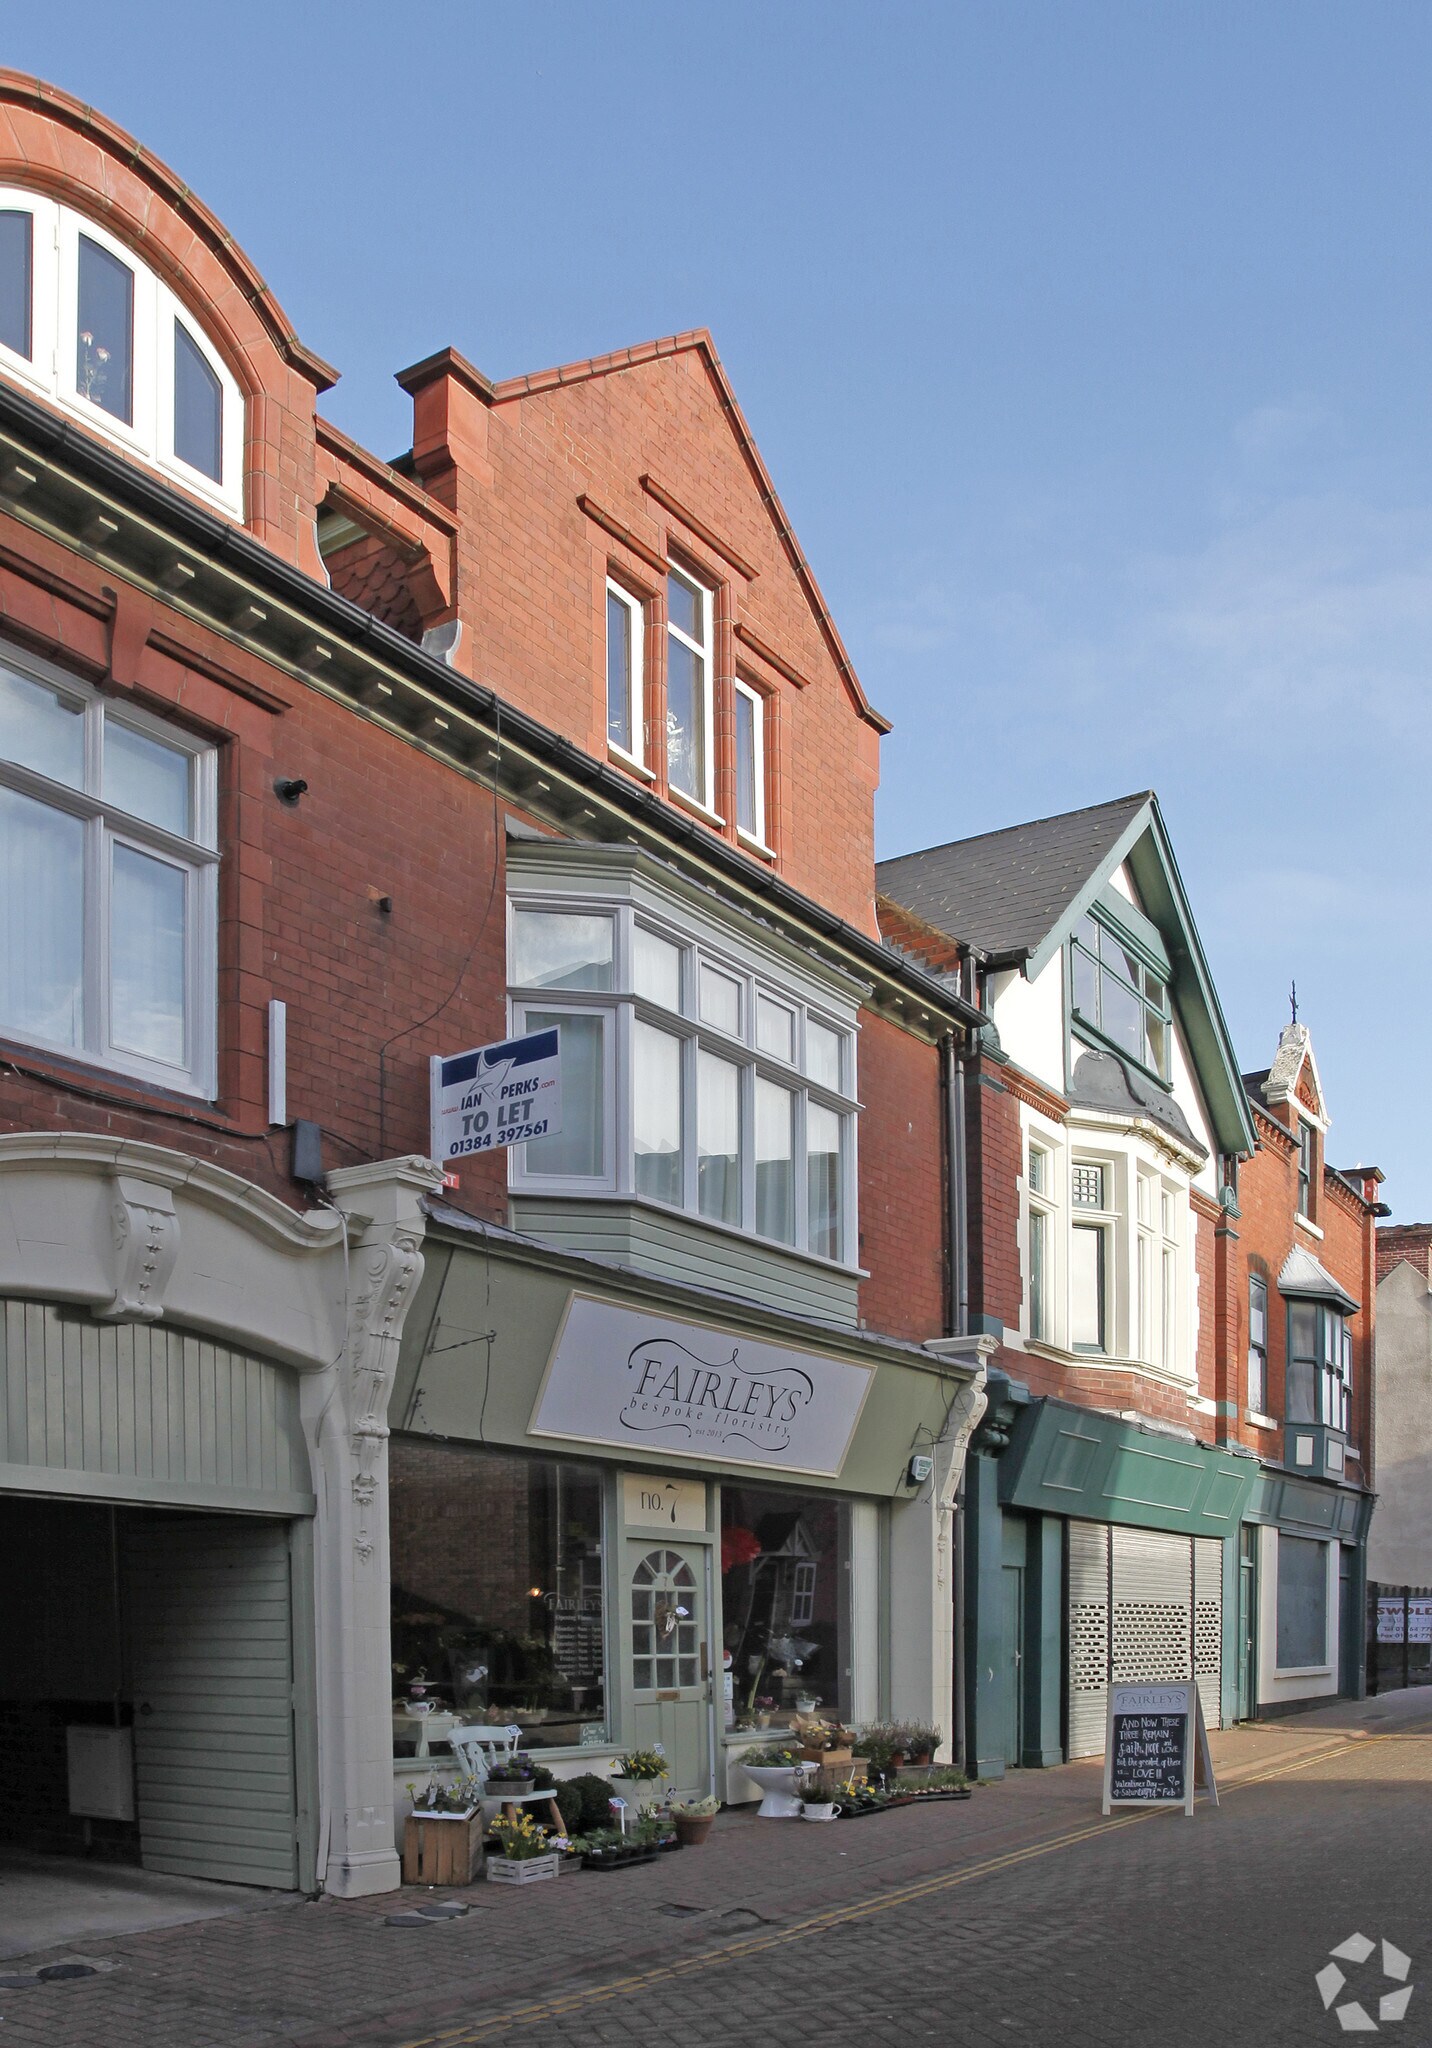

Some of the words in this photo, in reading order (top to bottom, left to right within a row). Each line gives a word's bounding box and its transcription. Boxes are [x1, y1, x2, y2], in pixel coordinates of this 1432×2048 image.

[462, 1110, 489, 1136] TO
[497, 1098, 534, 1128] LET
[450, 1133, 492, 1155] 01384
[497, 1119, 549, 1144] 397561
[634, 1358, 802, 1422] FAIRLEYS
[630, 1396, 703, 1420] bespoke
[714, 1411, 789, 1437] floristry
[695, 1429, 705, 1437] est
[1122, 1695, 1182, 1704] FAIRLEYS
[1121, 1717, 1140, 1730] AND
[1160, 1717, 1180, 1727] THESE
[1118, 1730, 1139, 1740] THREE
[1163, 1787, 1176, 1796] Feb
